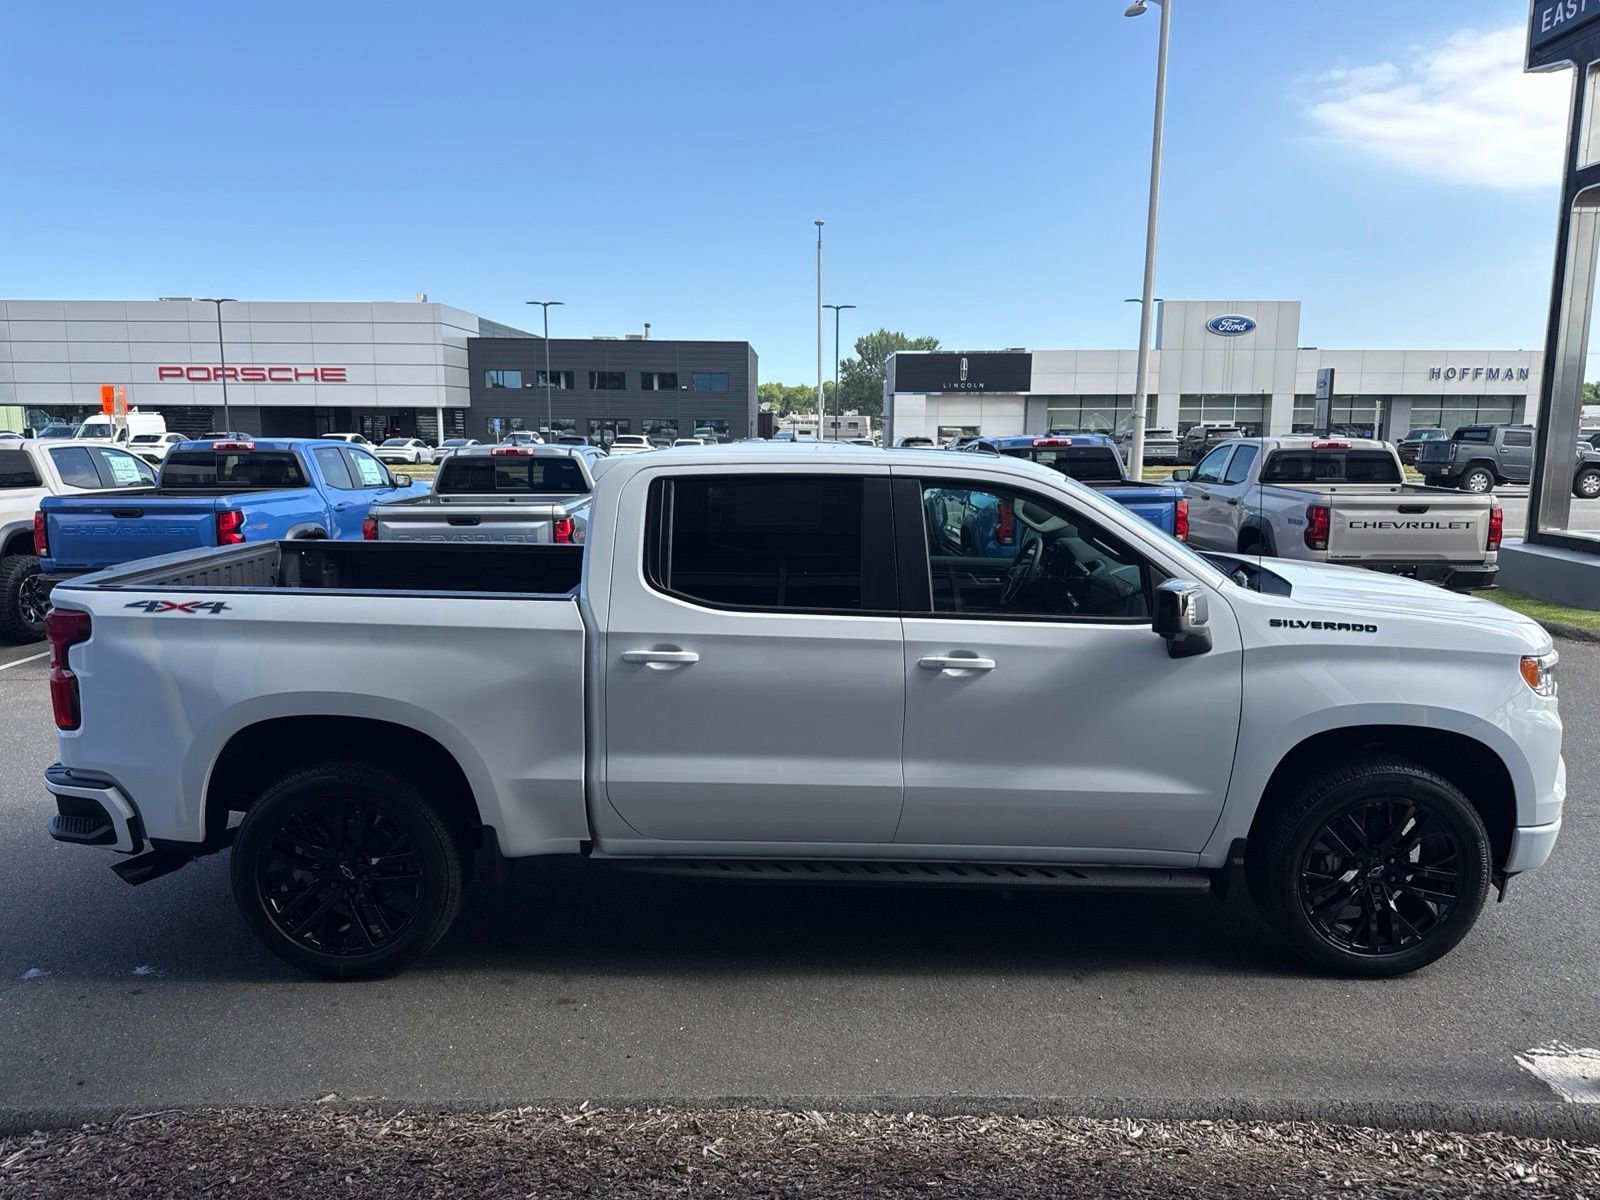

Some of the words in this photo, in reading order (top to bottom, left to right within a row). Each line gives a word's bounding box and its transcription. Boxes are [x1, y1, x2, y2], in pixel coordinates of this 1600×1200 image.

[1218, 318, 1248, 332] Ford
[158, 366, 347, 382] PORSCHE
[1429, 367, 1530, 381] HOFFMAN
[61, 526, 196, 537] CHEVROLET
[1349, 521, 1475, 530] CHEVROLET
[1269, 618, 1378, 634] SILVERADO
